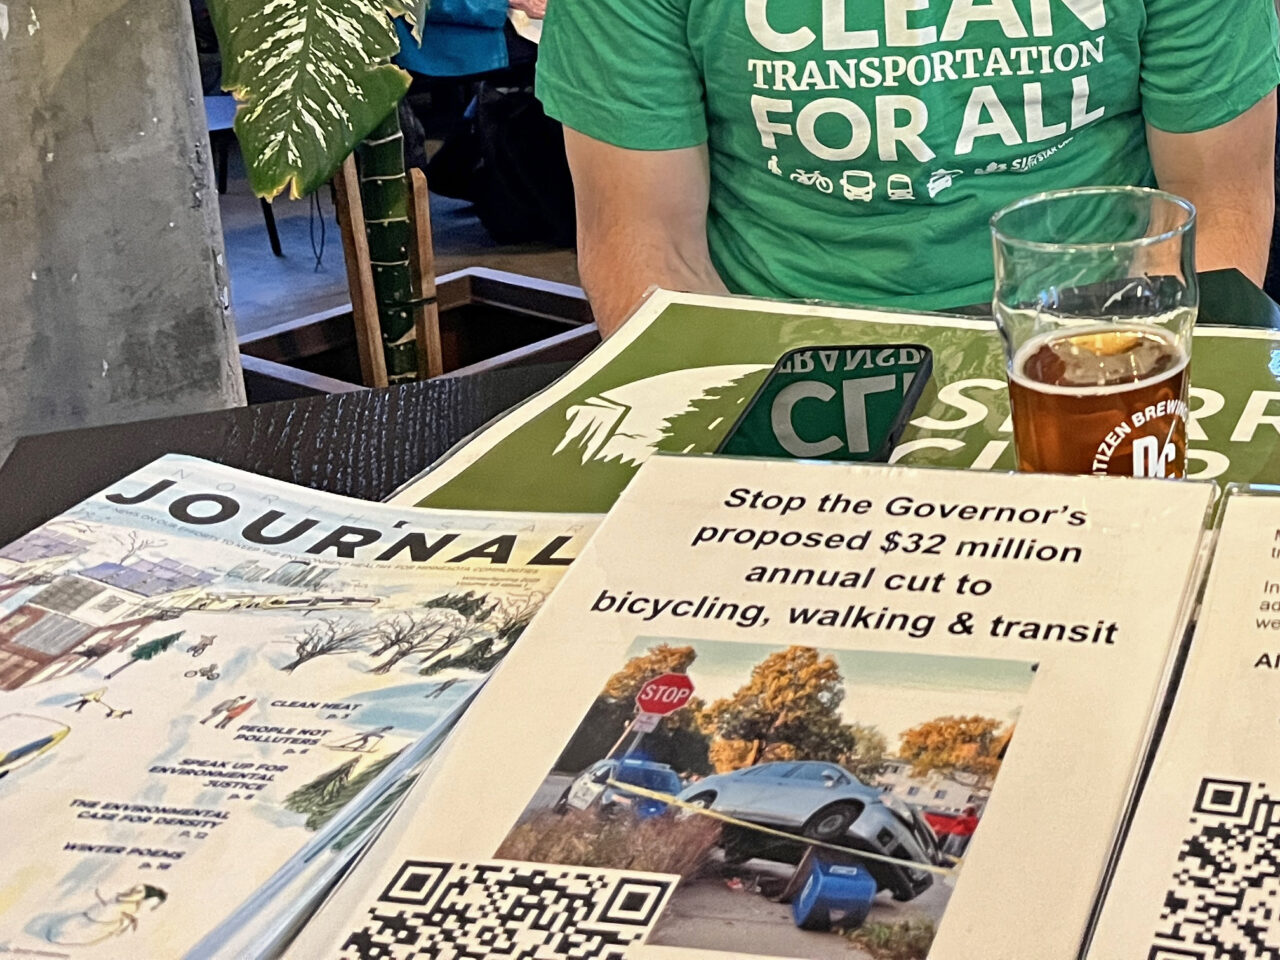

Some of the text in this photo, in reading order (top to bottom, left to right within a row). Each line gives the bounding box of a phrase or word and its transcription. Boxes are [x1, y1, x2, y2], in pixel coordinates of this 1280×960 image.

[748, 36, 1105, 92] TRANSPORTATION
[750, 74, 1106, 163] FOR ALL
[723, 487, 1088, 527] Stop the Governor's
[105, 479, 577, 567] JOURNAL
[690, 525, 1083, 564] proposed $32 million
[744, 565, 993, 597] annual cut to
[589, 589, 1119, 645] bicycling, walking & transit
[271, 700, 363, 711] CLEAN HEAT
[641, 684, 691, 703] STOP
[233, 734, 322, 746] POLLUTERS
[237, 725, 333, 737] PEOPLE NOT
[149, 765, 276, 782] ENVIRONMENTAL
[178, 758, 289, 772] SPEAK UP FOR
[203, 780, 268, 791] JUSTICE
